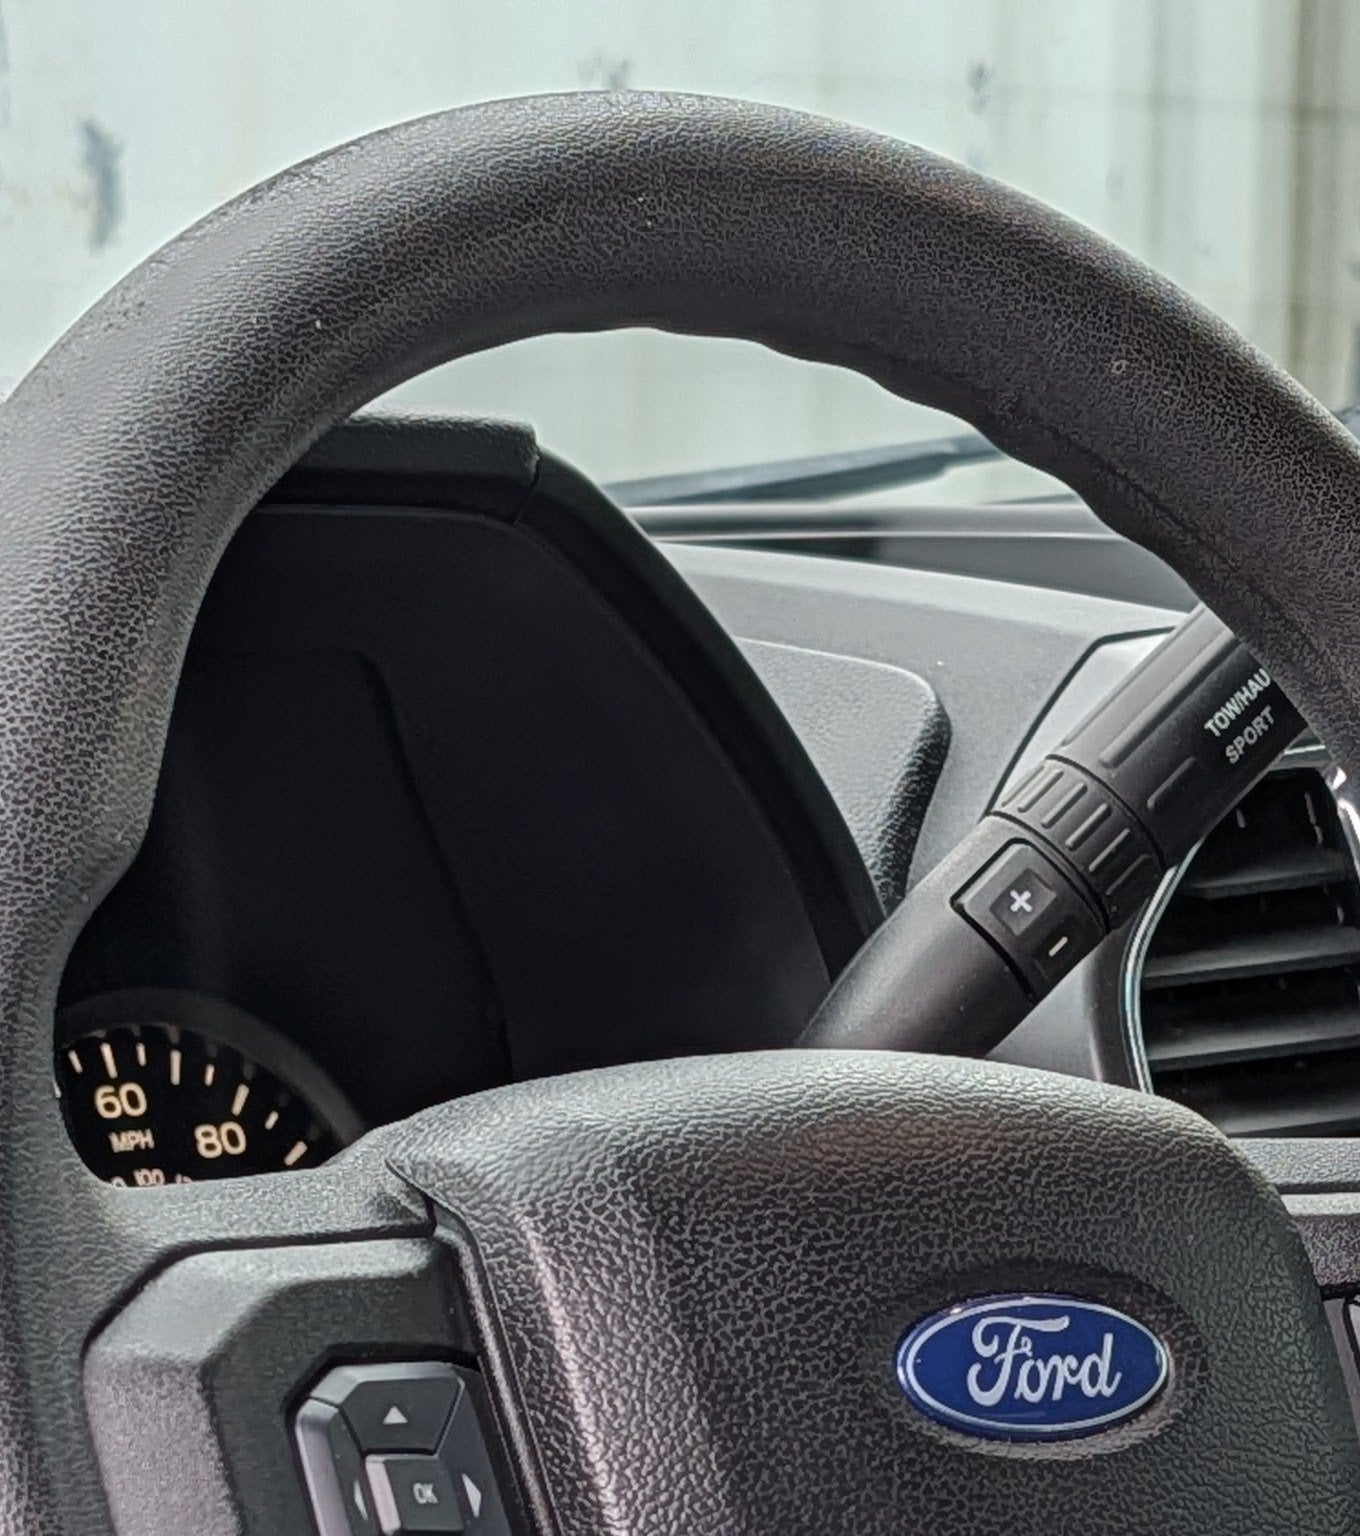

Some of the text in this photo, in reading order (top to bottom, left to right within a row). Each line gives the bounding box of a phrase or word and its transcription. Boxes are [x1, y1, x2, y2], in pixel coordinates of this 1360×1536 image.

[1225, 705, 1274, 764] SPORT
[94, 1083, 147, 1118] 60
[108, 1128, 155, 1153] MPH
[194, 1121, 246, 1158] 80
[967, 1315, 1122, 1406] Ford
[413, 1483, 438, 1504] OK
